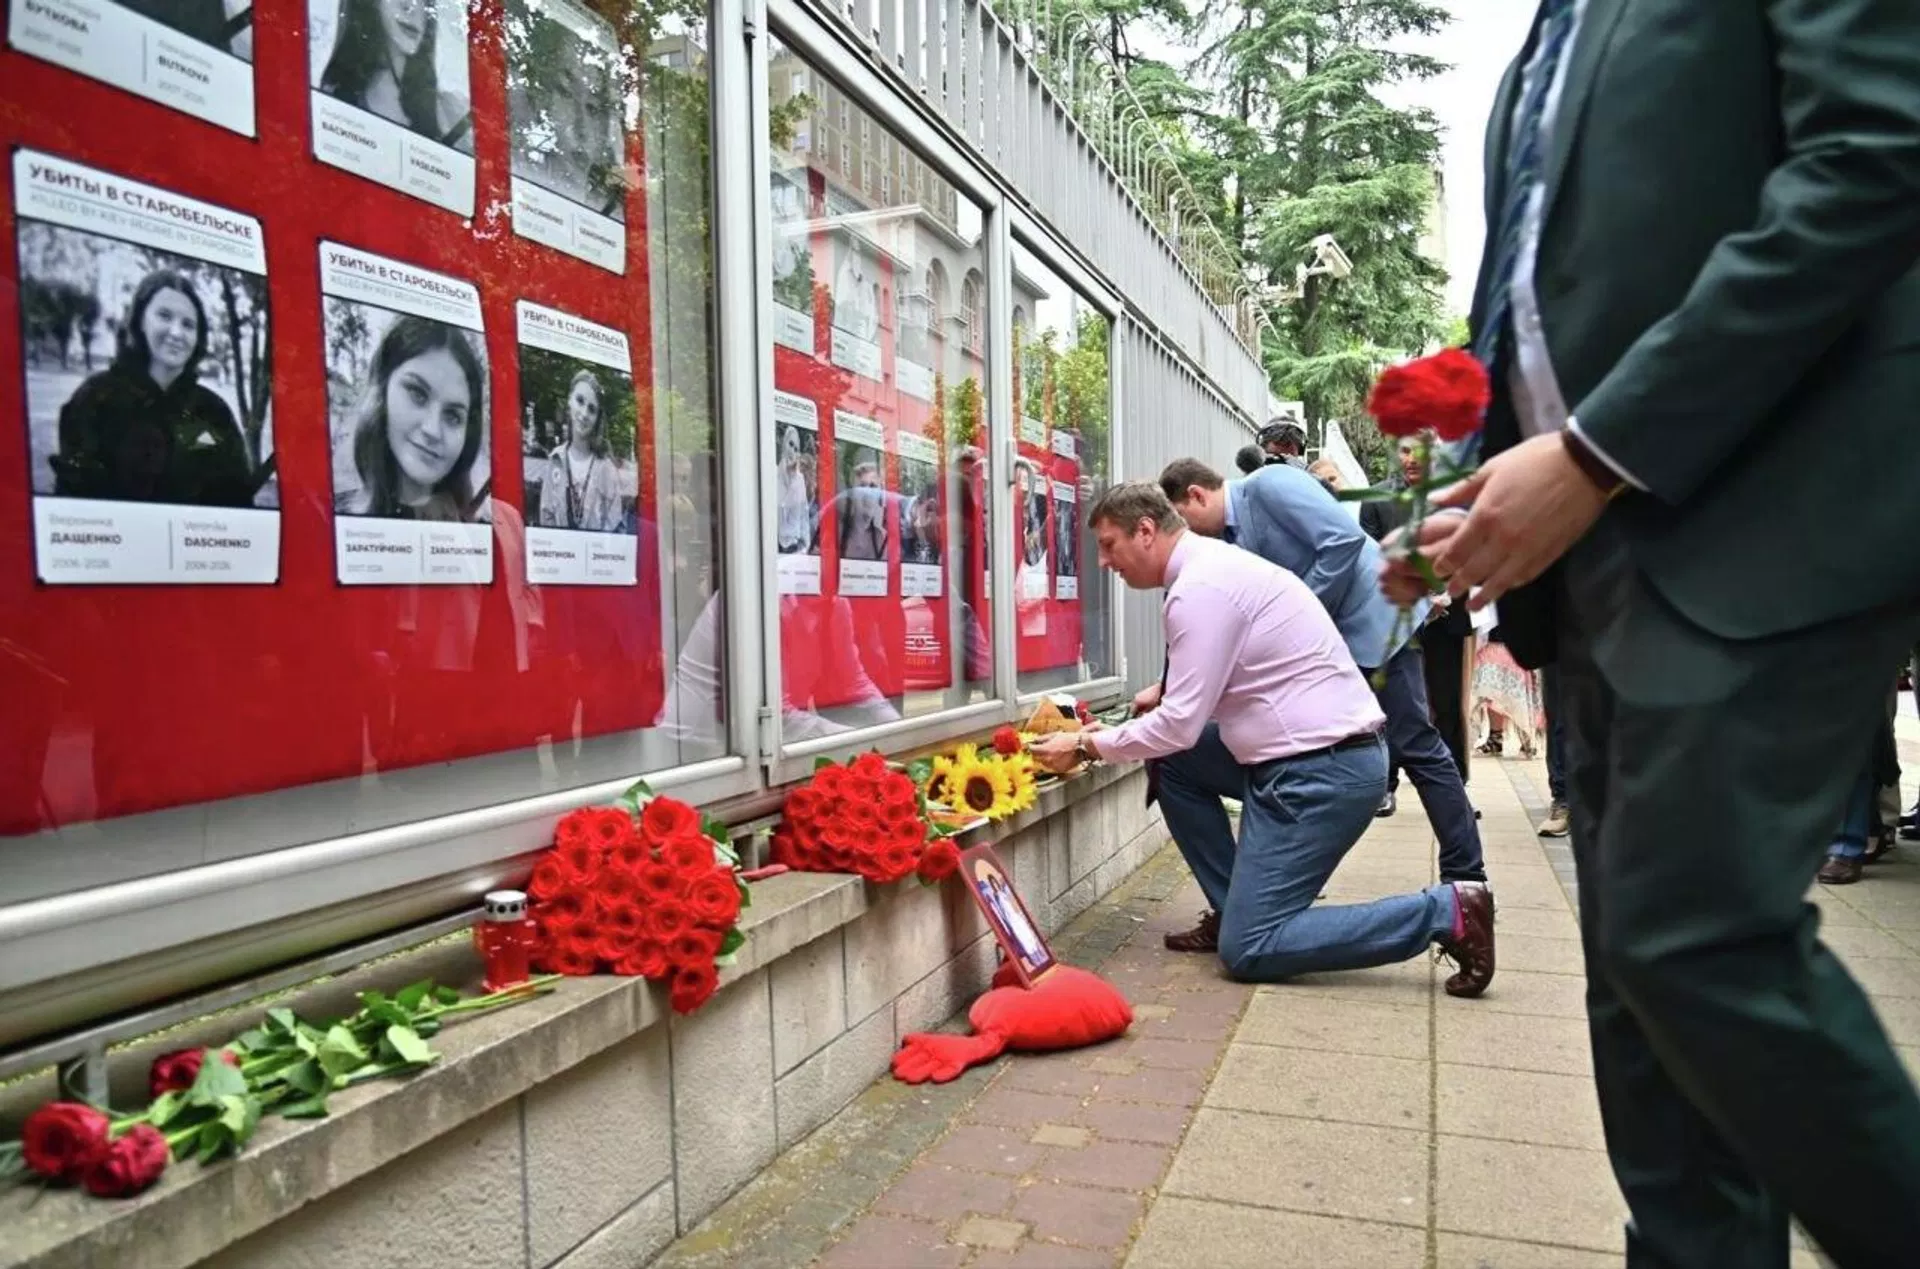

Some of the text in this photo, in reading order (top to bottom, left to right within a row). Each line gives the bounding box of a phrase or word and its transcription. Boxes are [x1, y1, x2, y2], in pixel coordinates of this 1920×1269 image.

[29, 163, 253, 240] УБИТЫ В СТАРОБЕЛЬСКЕ
[329, 252, 376, 274] УБИТЫ
[379, 266, 388, 278] В
[523, 309, 556, 328] УБИТЫ
[50, 532, 122, 545] ДАЩЕНКО
[184, 536, 251, 549] DASCHENKO
